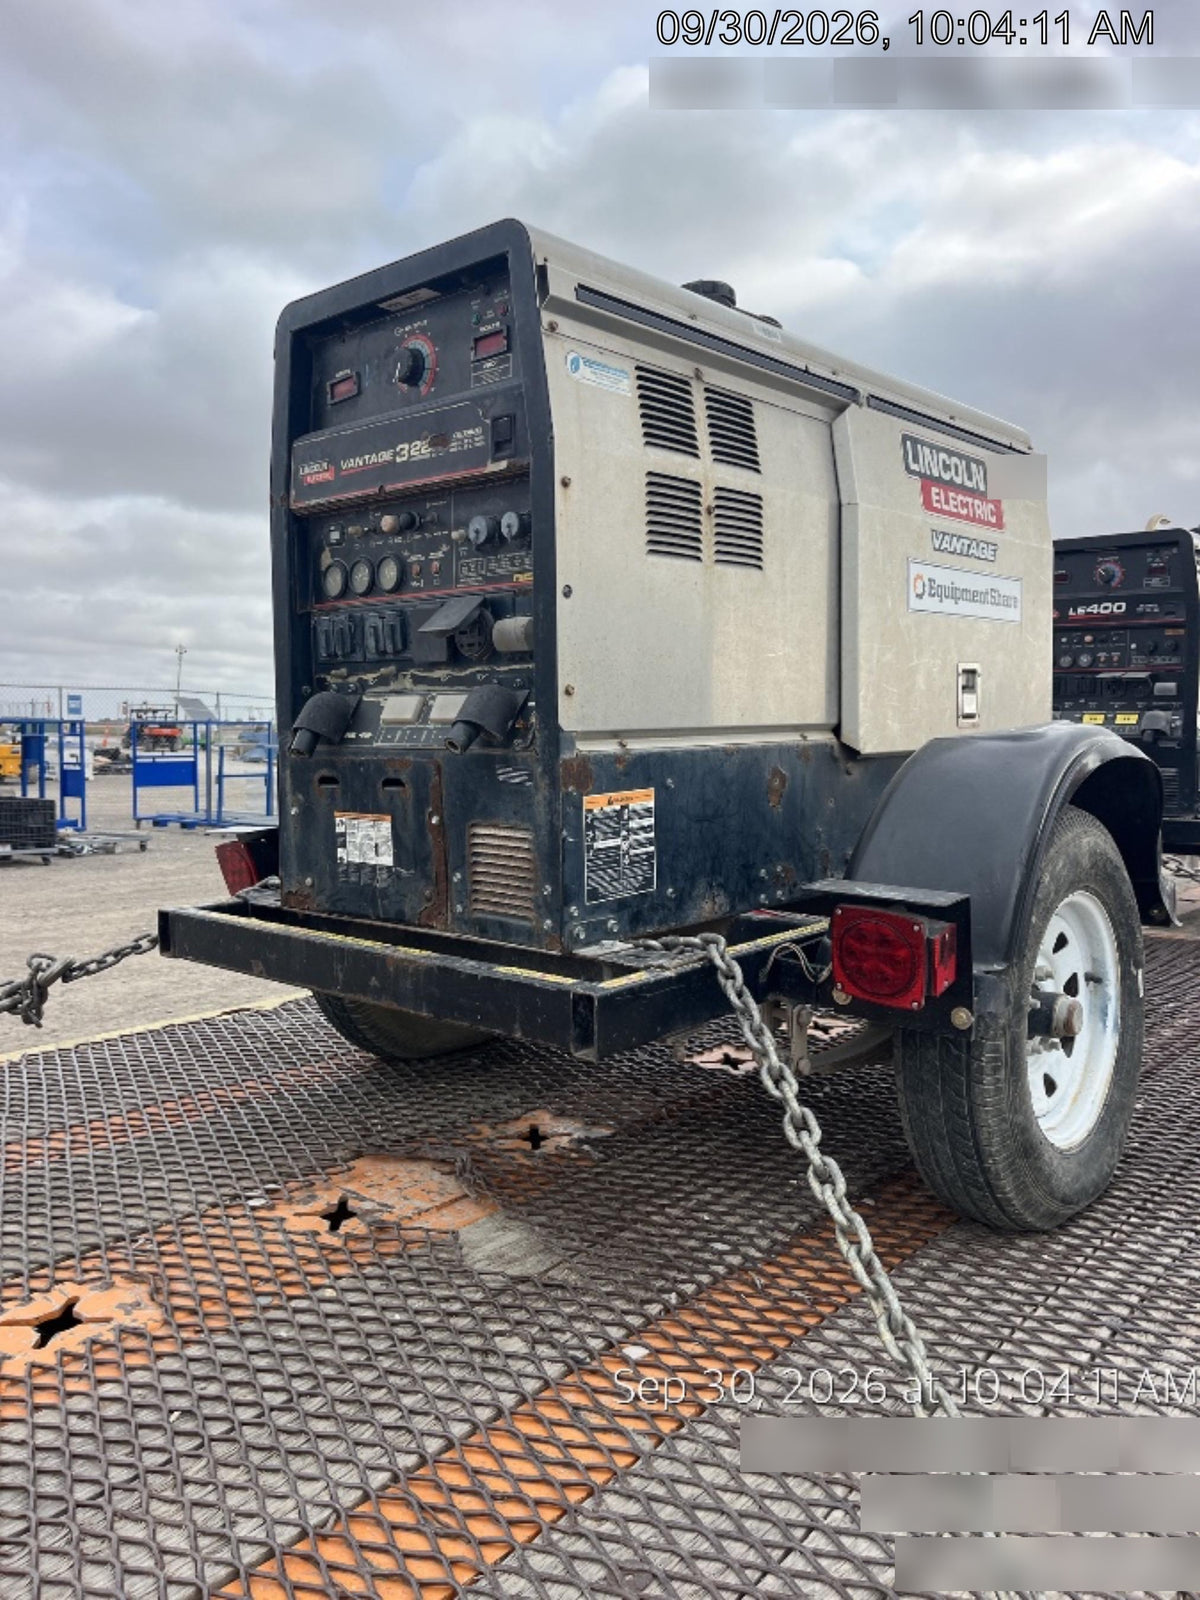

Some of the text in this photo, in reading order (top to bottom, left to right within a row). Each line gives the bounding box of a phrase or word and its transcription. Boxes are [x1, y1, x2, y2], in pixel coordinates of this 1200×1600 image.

[340, 449, 395, 470] VANTAGE
[906, 440, 985, 491] LINCOLN
[931, 486, 997, 524] ELECTRIC
[931, 529, 998, 562] VANTAGE
[927, 577, 1018, 609] EquipmentShare
